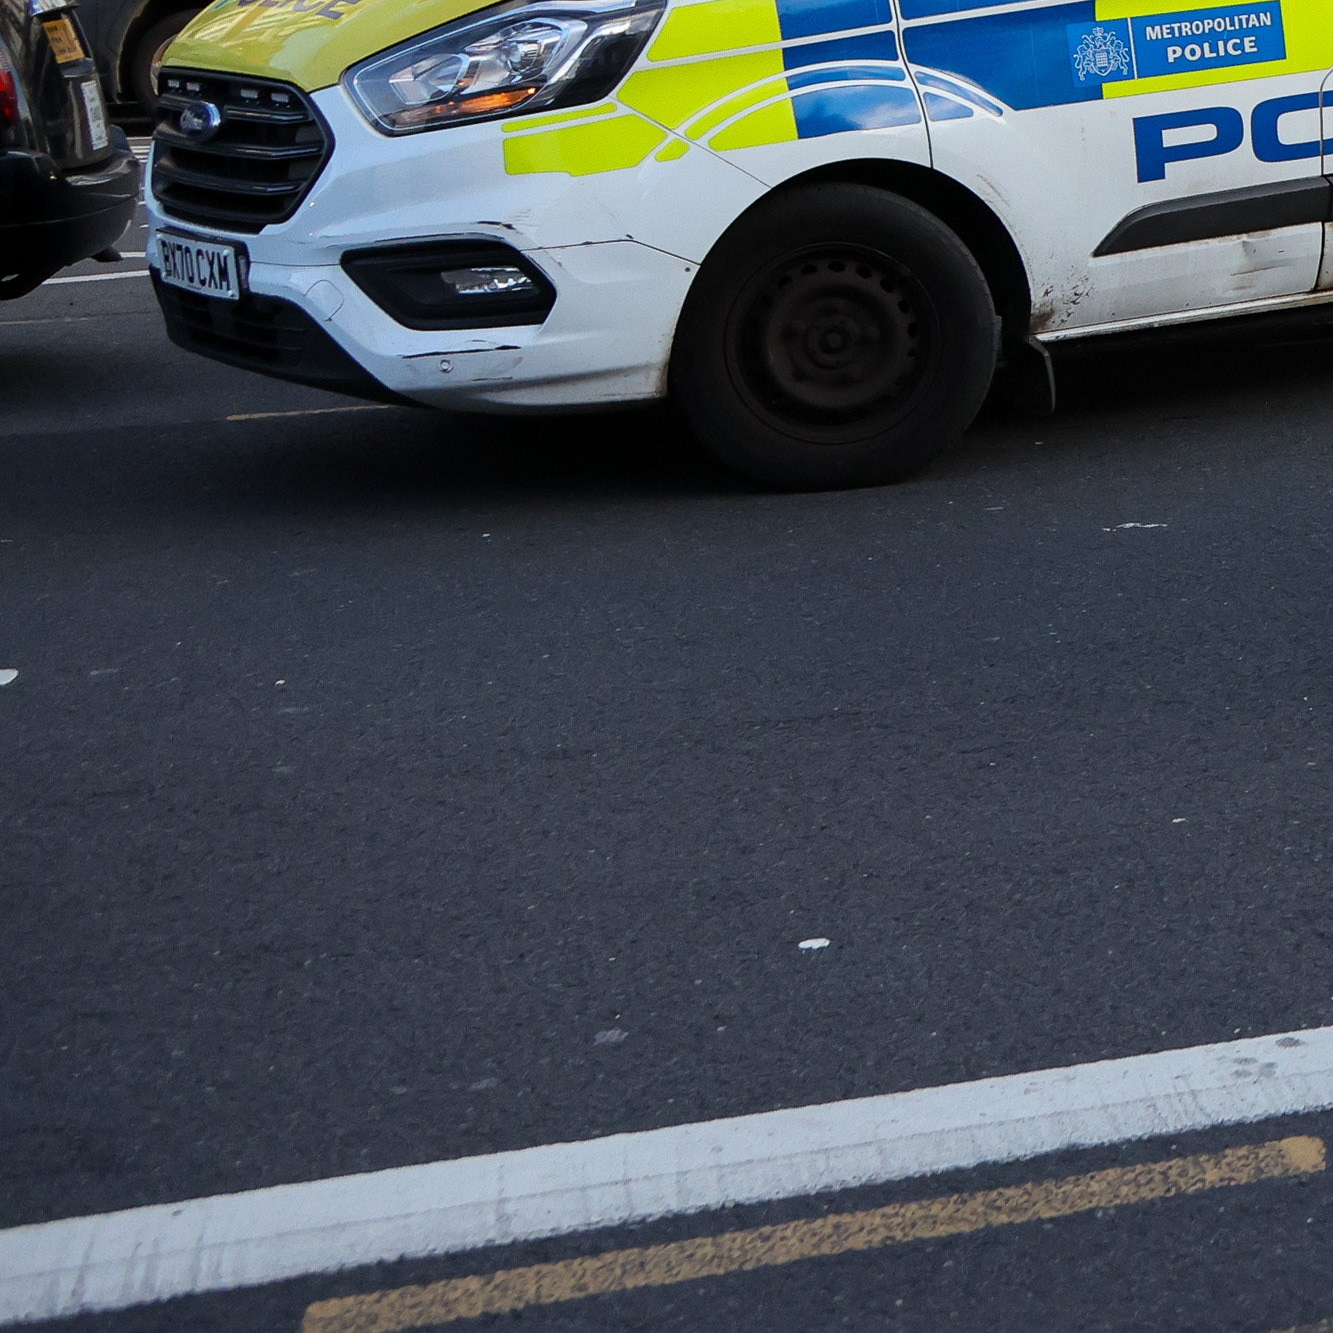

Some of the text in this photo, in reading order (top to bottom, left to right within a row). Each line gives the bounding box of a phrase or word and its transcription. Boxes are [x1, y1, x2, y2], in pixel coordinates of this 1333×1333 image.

[1145, 11, 1272, 41] METROPOLITAN
[1166, 37, 1258, 63] POLICE
[196, 248, 230, 291] CXM
